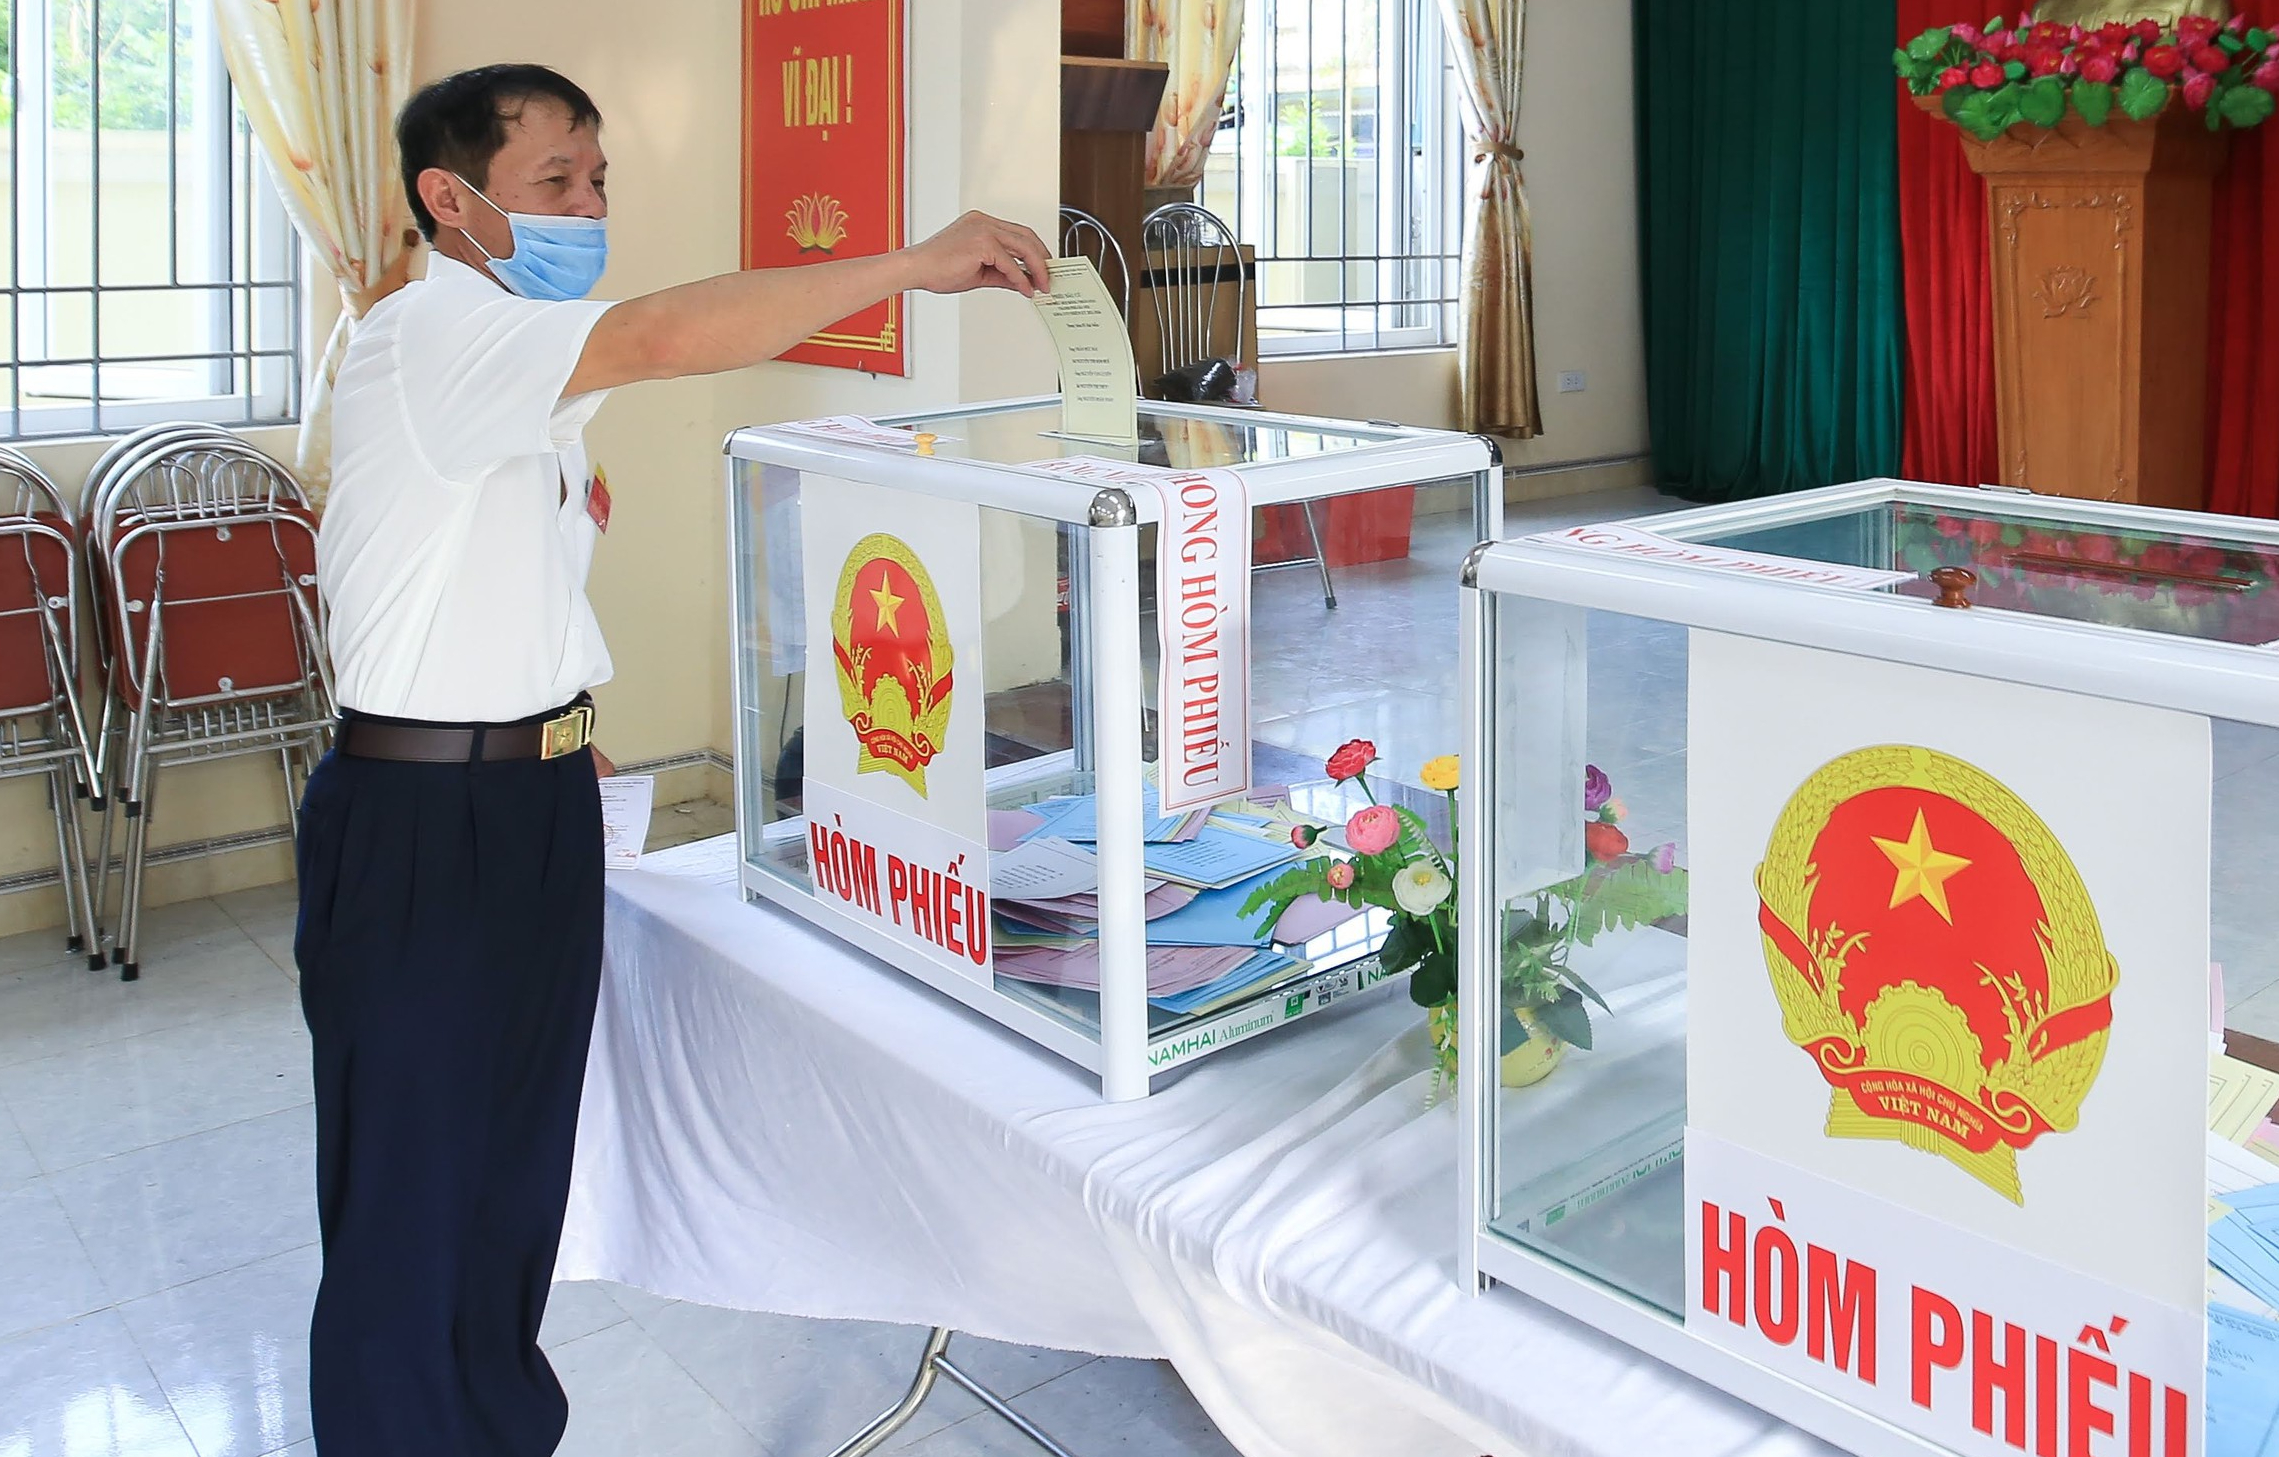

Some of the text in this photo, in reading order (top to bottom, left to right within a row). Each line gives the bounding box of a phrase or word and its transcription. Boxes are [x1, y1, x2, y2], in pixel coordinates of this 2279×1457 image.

[782, 46, 852, 141] VĨ ĐẠI !
[1181, 571, 1228, 667] HÒM
[1183, 671, 1230, 787] PHIẾU
[810, 813, 987, 966] HÒM PHIẾU
[1148, 1012, 1274, 1066] NAMHAI Aluminum
[1878, 1095, 1969, 1140] VIỆT NAM
[1701, 1195, 1877, 1388] HÒM
